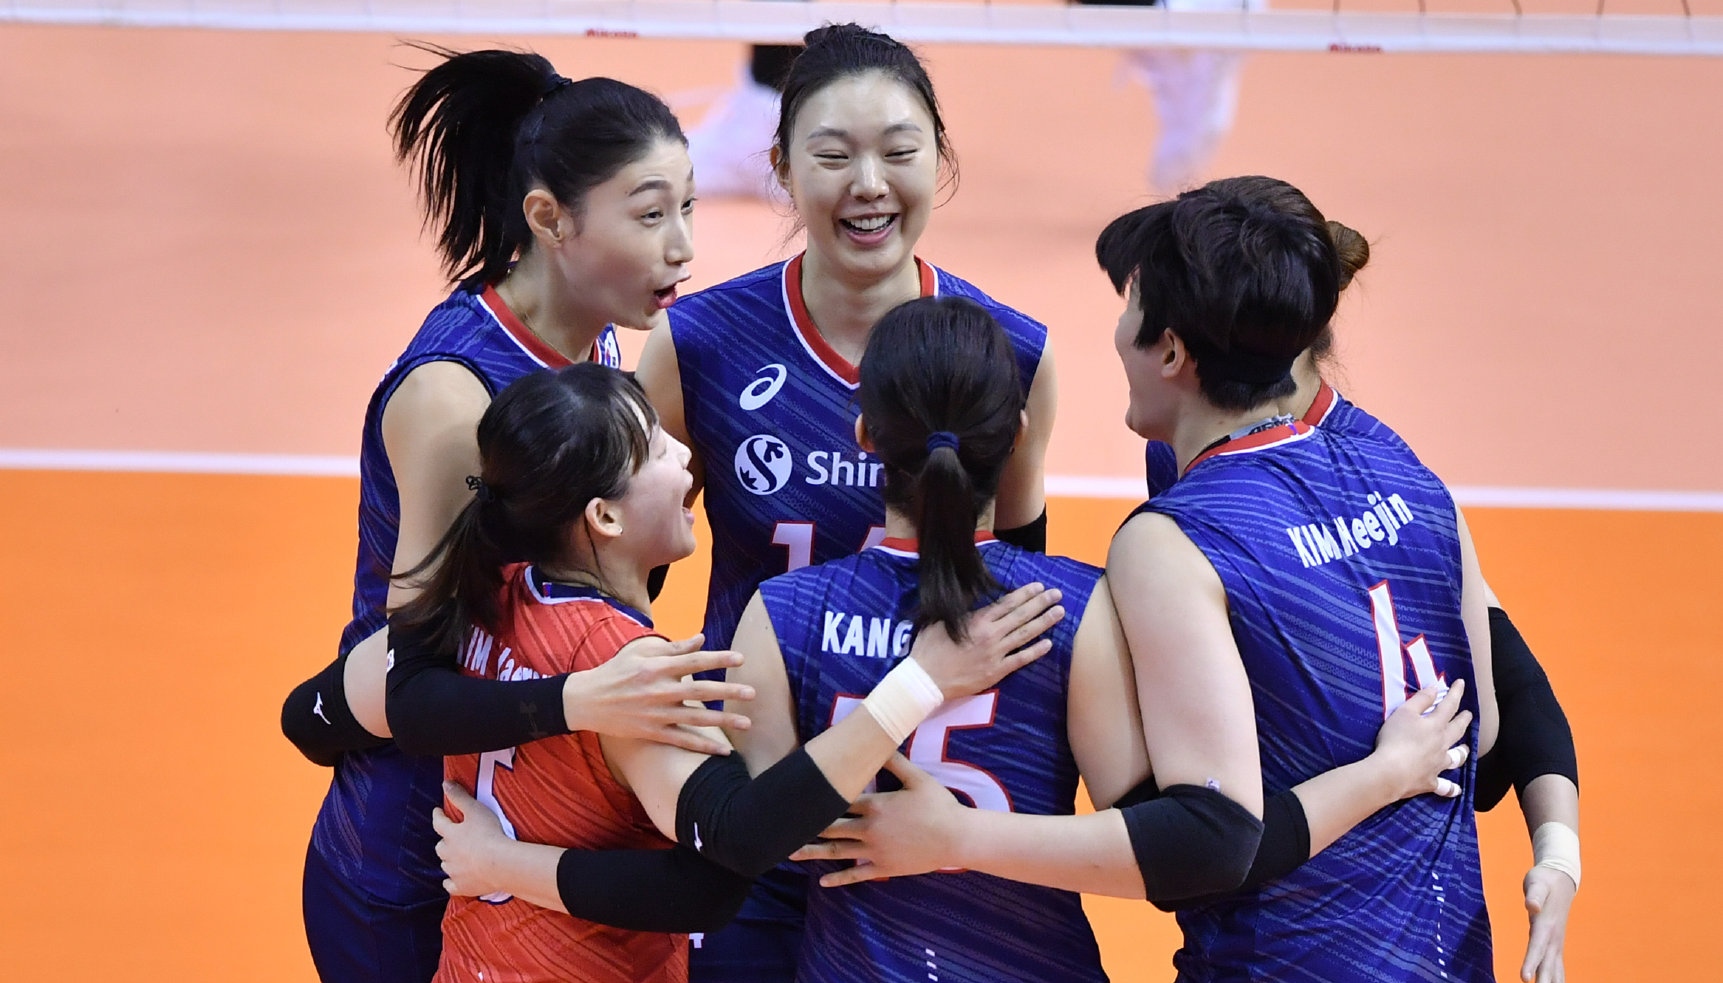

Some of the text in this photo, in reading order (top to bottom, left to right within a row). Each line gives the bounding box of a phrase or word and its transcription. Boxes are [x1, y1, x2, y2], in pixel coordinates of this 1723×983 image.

[1286, 491, 1414, 568] KIM Heejin
[821, 610, 914, 659] KANG
[1368, 579, 1450, 721] 4
